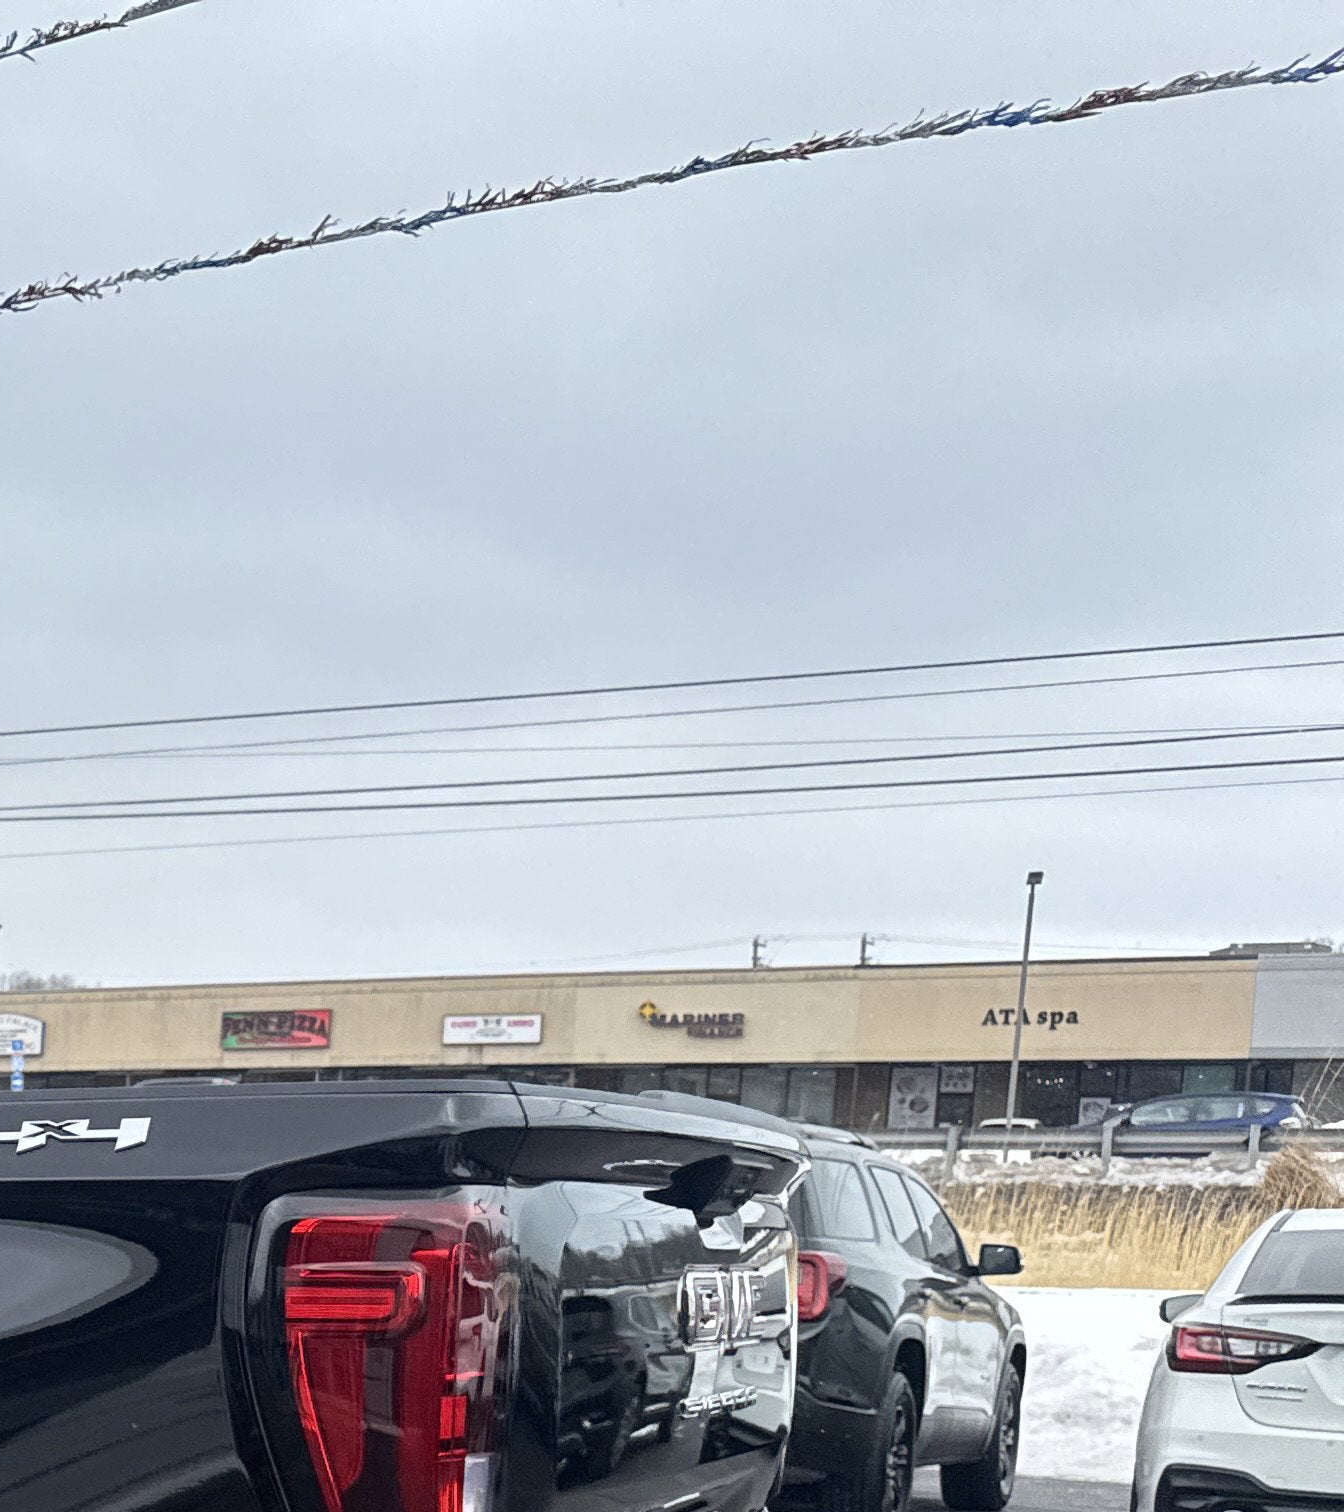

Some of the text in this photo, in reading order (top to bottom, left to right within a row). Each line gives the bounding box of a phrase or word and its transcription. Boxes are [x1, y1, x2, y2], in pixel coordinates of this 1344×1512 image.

[649, 1013, 744, 1028] MARINER
[981, 1008, 1079, 1031] ATA spa
